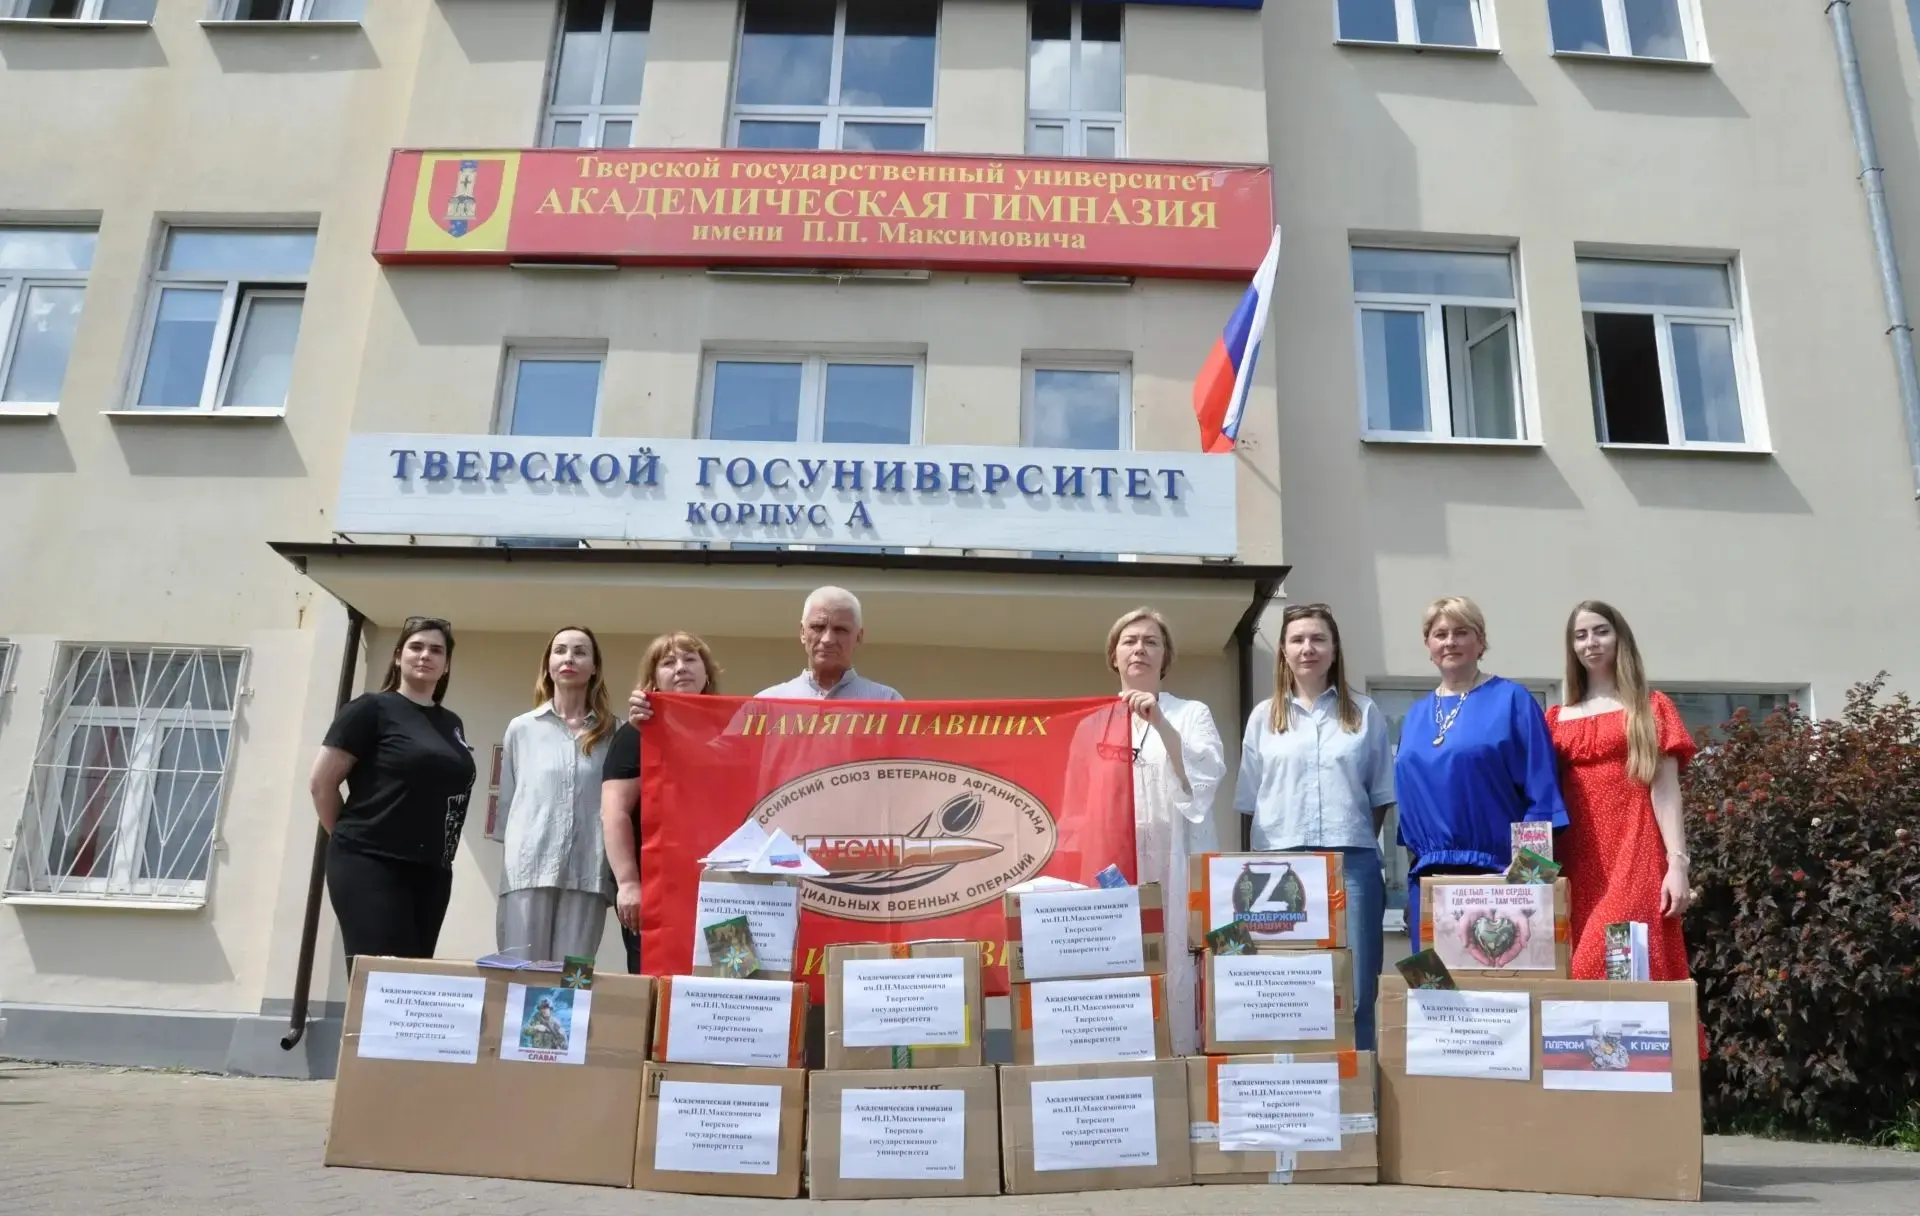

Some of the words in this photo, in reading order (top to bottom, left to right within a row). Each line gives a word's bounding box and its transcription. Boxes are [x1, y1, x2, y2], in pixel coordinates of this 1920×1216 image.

[576, 155, 720, 184] Тверской
[731, 161, 1005, 186] государственный
[1016, 166, 1213, 194] университет
[535, 187, 951, 221] АКАДЕМИЧЕСКАЯ
[964, 192, 1220, 229] ГИМНАЗИЯ
[692, 225, 784, 242] имени
[802, 221, 868, 243] П.П.
[878, 222, 1087, 249] Максимовича
[390, 446, 661, 487] ТВЕРСКОЙ
[695, 456, 1185, 501] ГОСУНИВЕРСИТЕТ
[685, 501, 828, 528] КОРПУС
[845, 500, 873, 528] А
[741, 713, 887, 738] ПАМЯТИ
[896, 713, 1052, 738] ПАВШИХ
[759, 778, 825, 826] ССИЙСКИЙ
[830, 770, 871, 786] СОЮЗ
[877, 768, 957, 784] ВЕТЕРАНОВ
[963, 777, 1046, 835] АФГАНИСТАНА
[802, 887, 881, 912] ИАЛЬНЫХ
[887, 891, 961, 912] ВОЕННЫХ
[966, 852, 1036, 898] ОПЕРАЦИЙ
[700, 895, 756, 906] Академическая
[1034, 904, 1092, 914] Академическая
[1093, 903, 1129, 911] гимназия
[1235, 912, 1306, 923] ПОДДЕРЖИМ
[1064, 926, 1102, 935] Тверского
[1050, 935, 1116, 946] государственного
[1059, 946, 1110, 956] университета
[856, 973, 915, 981] Академическая
[1228, 969, 1285, 977] Академическая
[1287, 969, 1322, 977] гимназия
[379, 986, 437, 998] Академическая
[438, 990, 473, 999] гимназия
[684, 990, 743, 1000] Академическая
[743, 994, 781, 1002] гимназия
[1044, 994, 1104, 1003] Академическая
[1105, 992, 1141, 1000] гимназия
[1257, 990, 1296, 999] Тверского
[885, 996, 925, 1004] Тверского
[871, 1005, 939, 1015] государственного
[1243, 1001, 1309, 1010] государственного
[1420, 1003, 1480, 1014] Академическая
[1481, 1006, 1518, 1015] гимназия
[404, 1010, 443, 1020] Тверского
[712, 1013, 751, 1023] Тверского
[1075, 1015, 1114, 1025] Тверского
[1251, 1011, 1302, 1020] университета
[879, 1016, 931, 1025] университета
[389, 1020, 455, 1032] государственного
[697, 1023, 764, 1034] государственного
[1061, 1024, 1128, 1036] государственного
[395, 1031, 446, 1041] университета
[1450, 1027, 1489, 1036] Тверского
[704, 1034, 756, 1044] университета
[1069, 1036, 1121, 1047] университета
[1435, 1037, 1503, 1048] государственного
[1544, 1040, 1585, 1050] ПЛЕЧОМ
[1630, 1041, 1639, 1051] К
[1640, 1041, 1670, 1051] ПЛЕЧУ
[528, 1053, 557, 1062] СЛАВА!
[1441, 1047, 1495, 1058] университета
[1232, 1078, 1291, 1086] Академическая
[1292, 1078, 1328, 1086] гимназия
[672, 1096, 732, 1107] Академическая
[732, 1100, 769, 1108] гимназия
[1045, 1094, 1105, 1104] Академическая
[1106, 1092, 1142, 1101] гимназия
[854, 1104, 915, 1112] Академическая
[916, 1105, 953, 1113] гимназия
[1262, 1100, 1301, 1109] Тверского
[1247, 1110, 1315, 1120] государственного
[700, 1119, 739, 1130] Тверского
[1076, 1116, 1115, 1126] Тверского
[884, 1126, 924, 1136] Тверского
[1061, 1126, 1129, 1137] государственного
[1255, 1122, 1307, 1131] университета
[685, 1130, 752, 1141] государственного
[692, 1141, 744, 1151] университета
[869, 1137, 938, 1147] государственного
[1070, 1137, 1122, 1147] университета
[876, 1148, 929, 1158] университета
